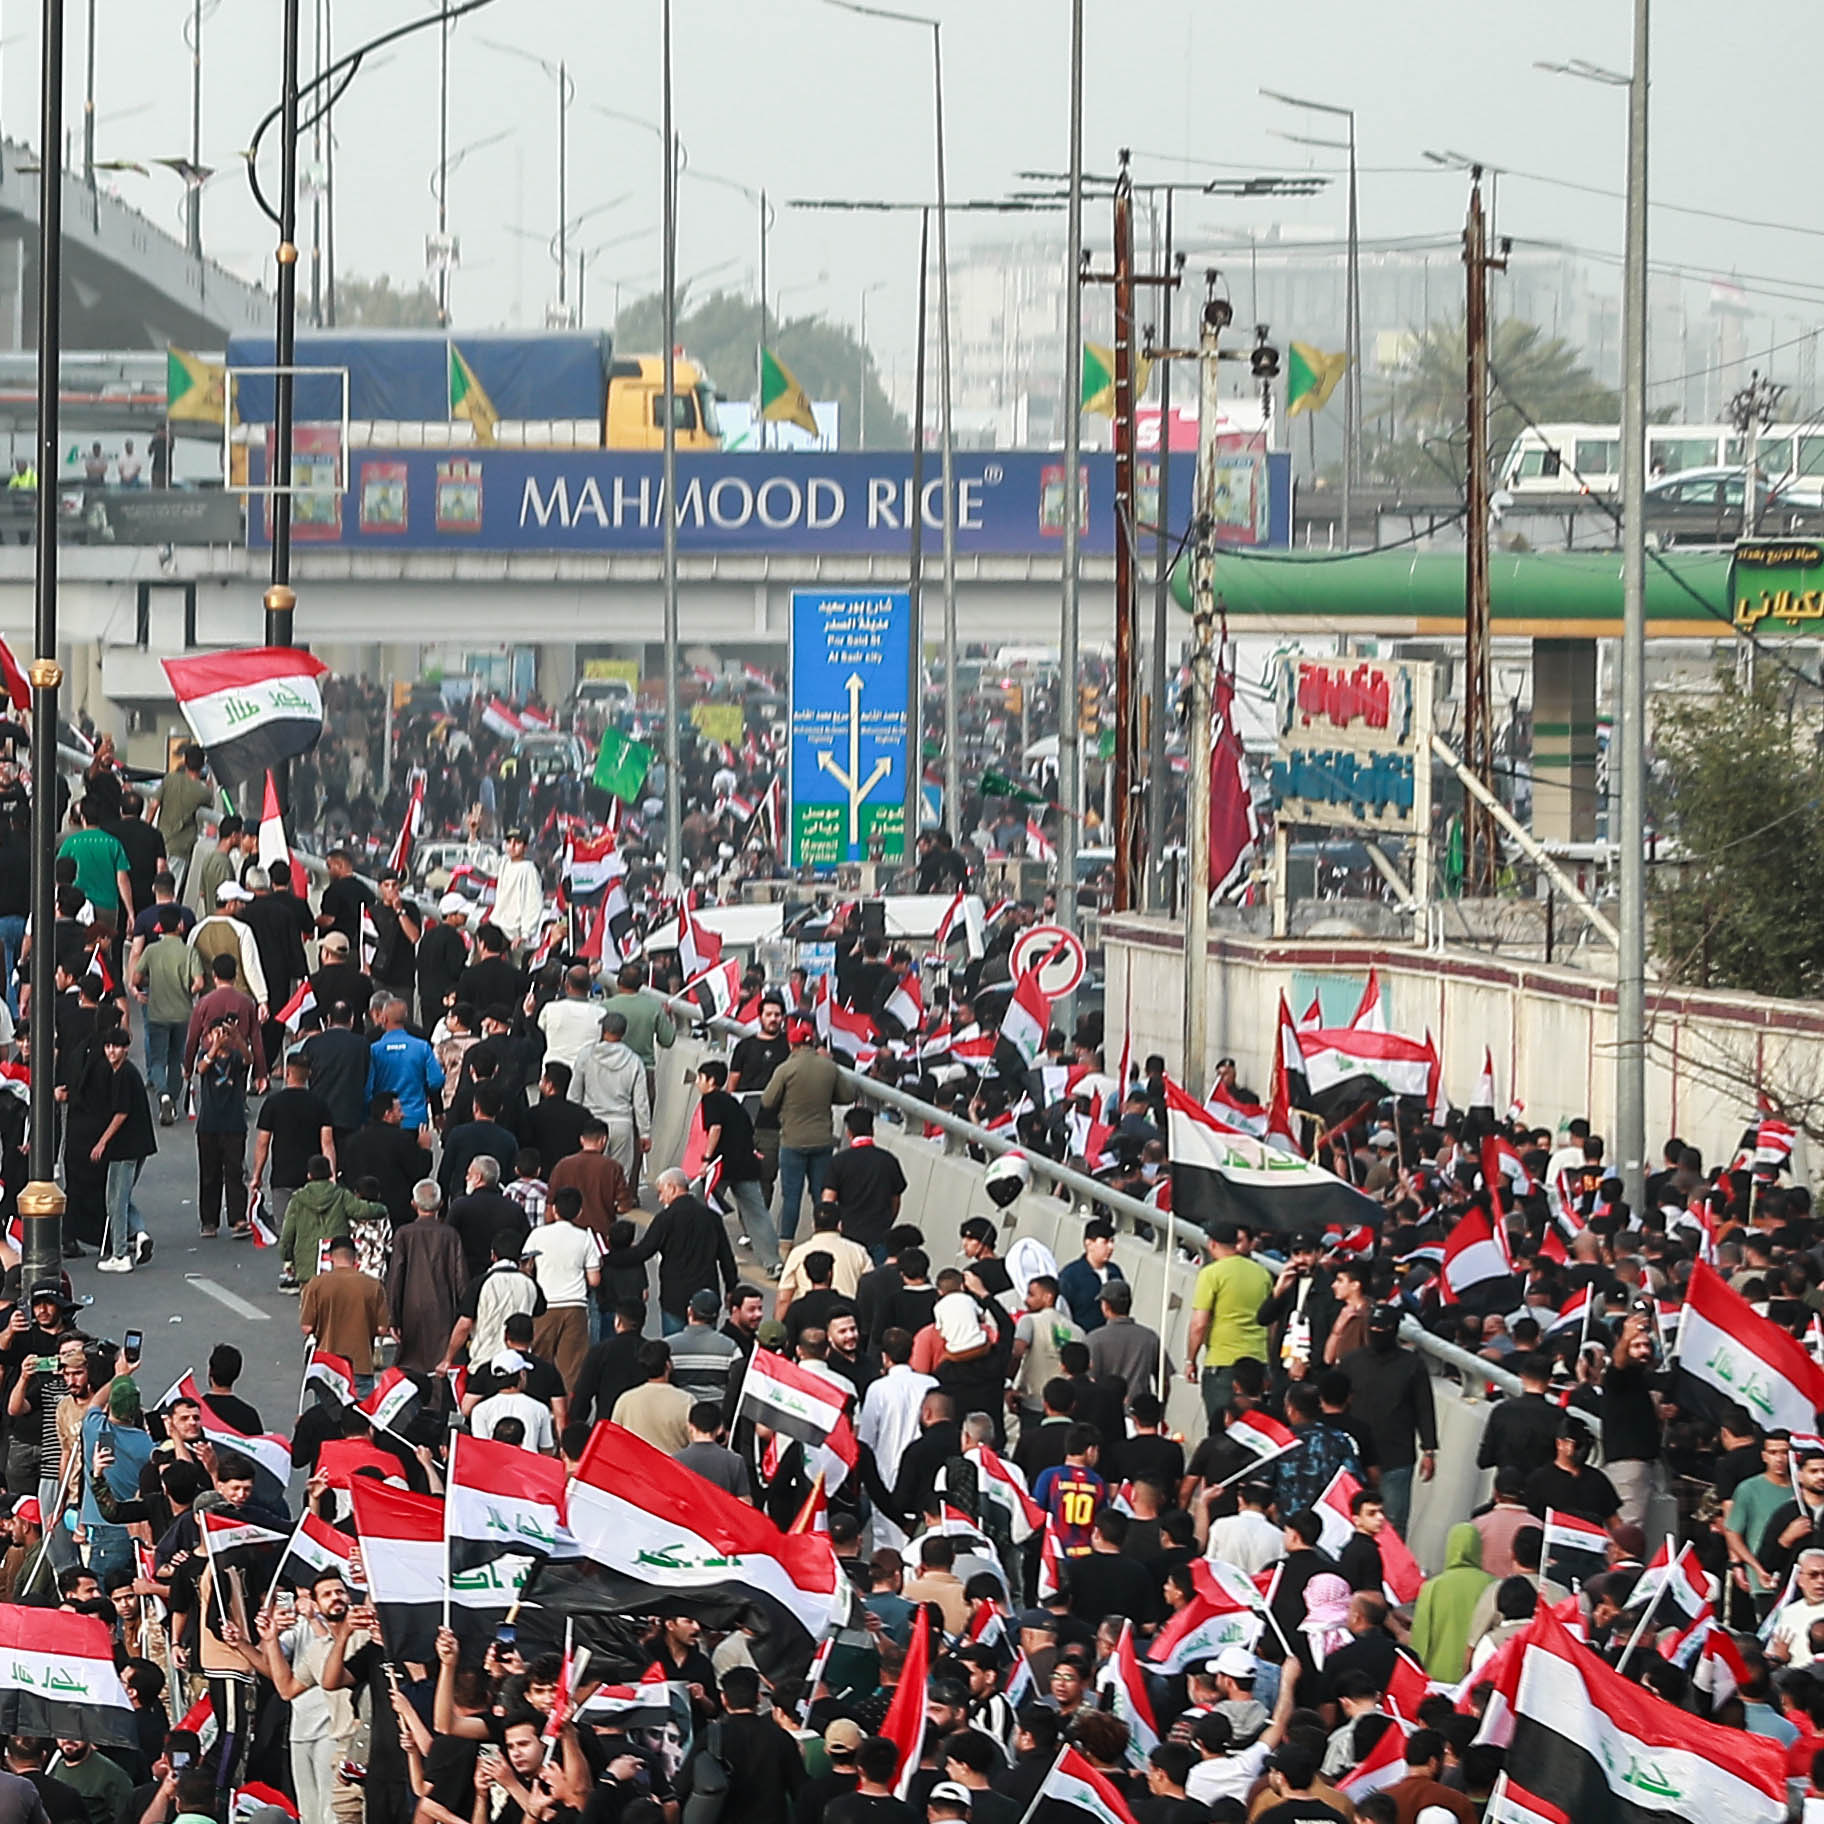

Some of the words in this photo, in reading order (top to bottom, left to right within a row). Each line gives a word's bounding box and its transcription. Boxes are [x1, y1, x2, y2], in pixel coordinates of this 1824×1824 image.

[518, 475, 846, 530] MAHMOOD
[867, 475, 984, 530] RICE
[1063, 1492, 1094, 1525] 10
